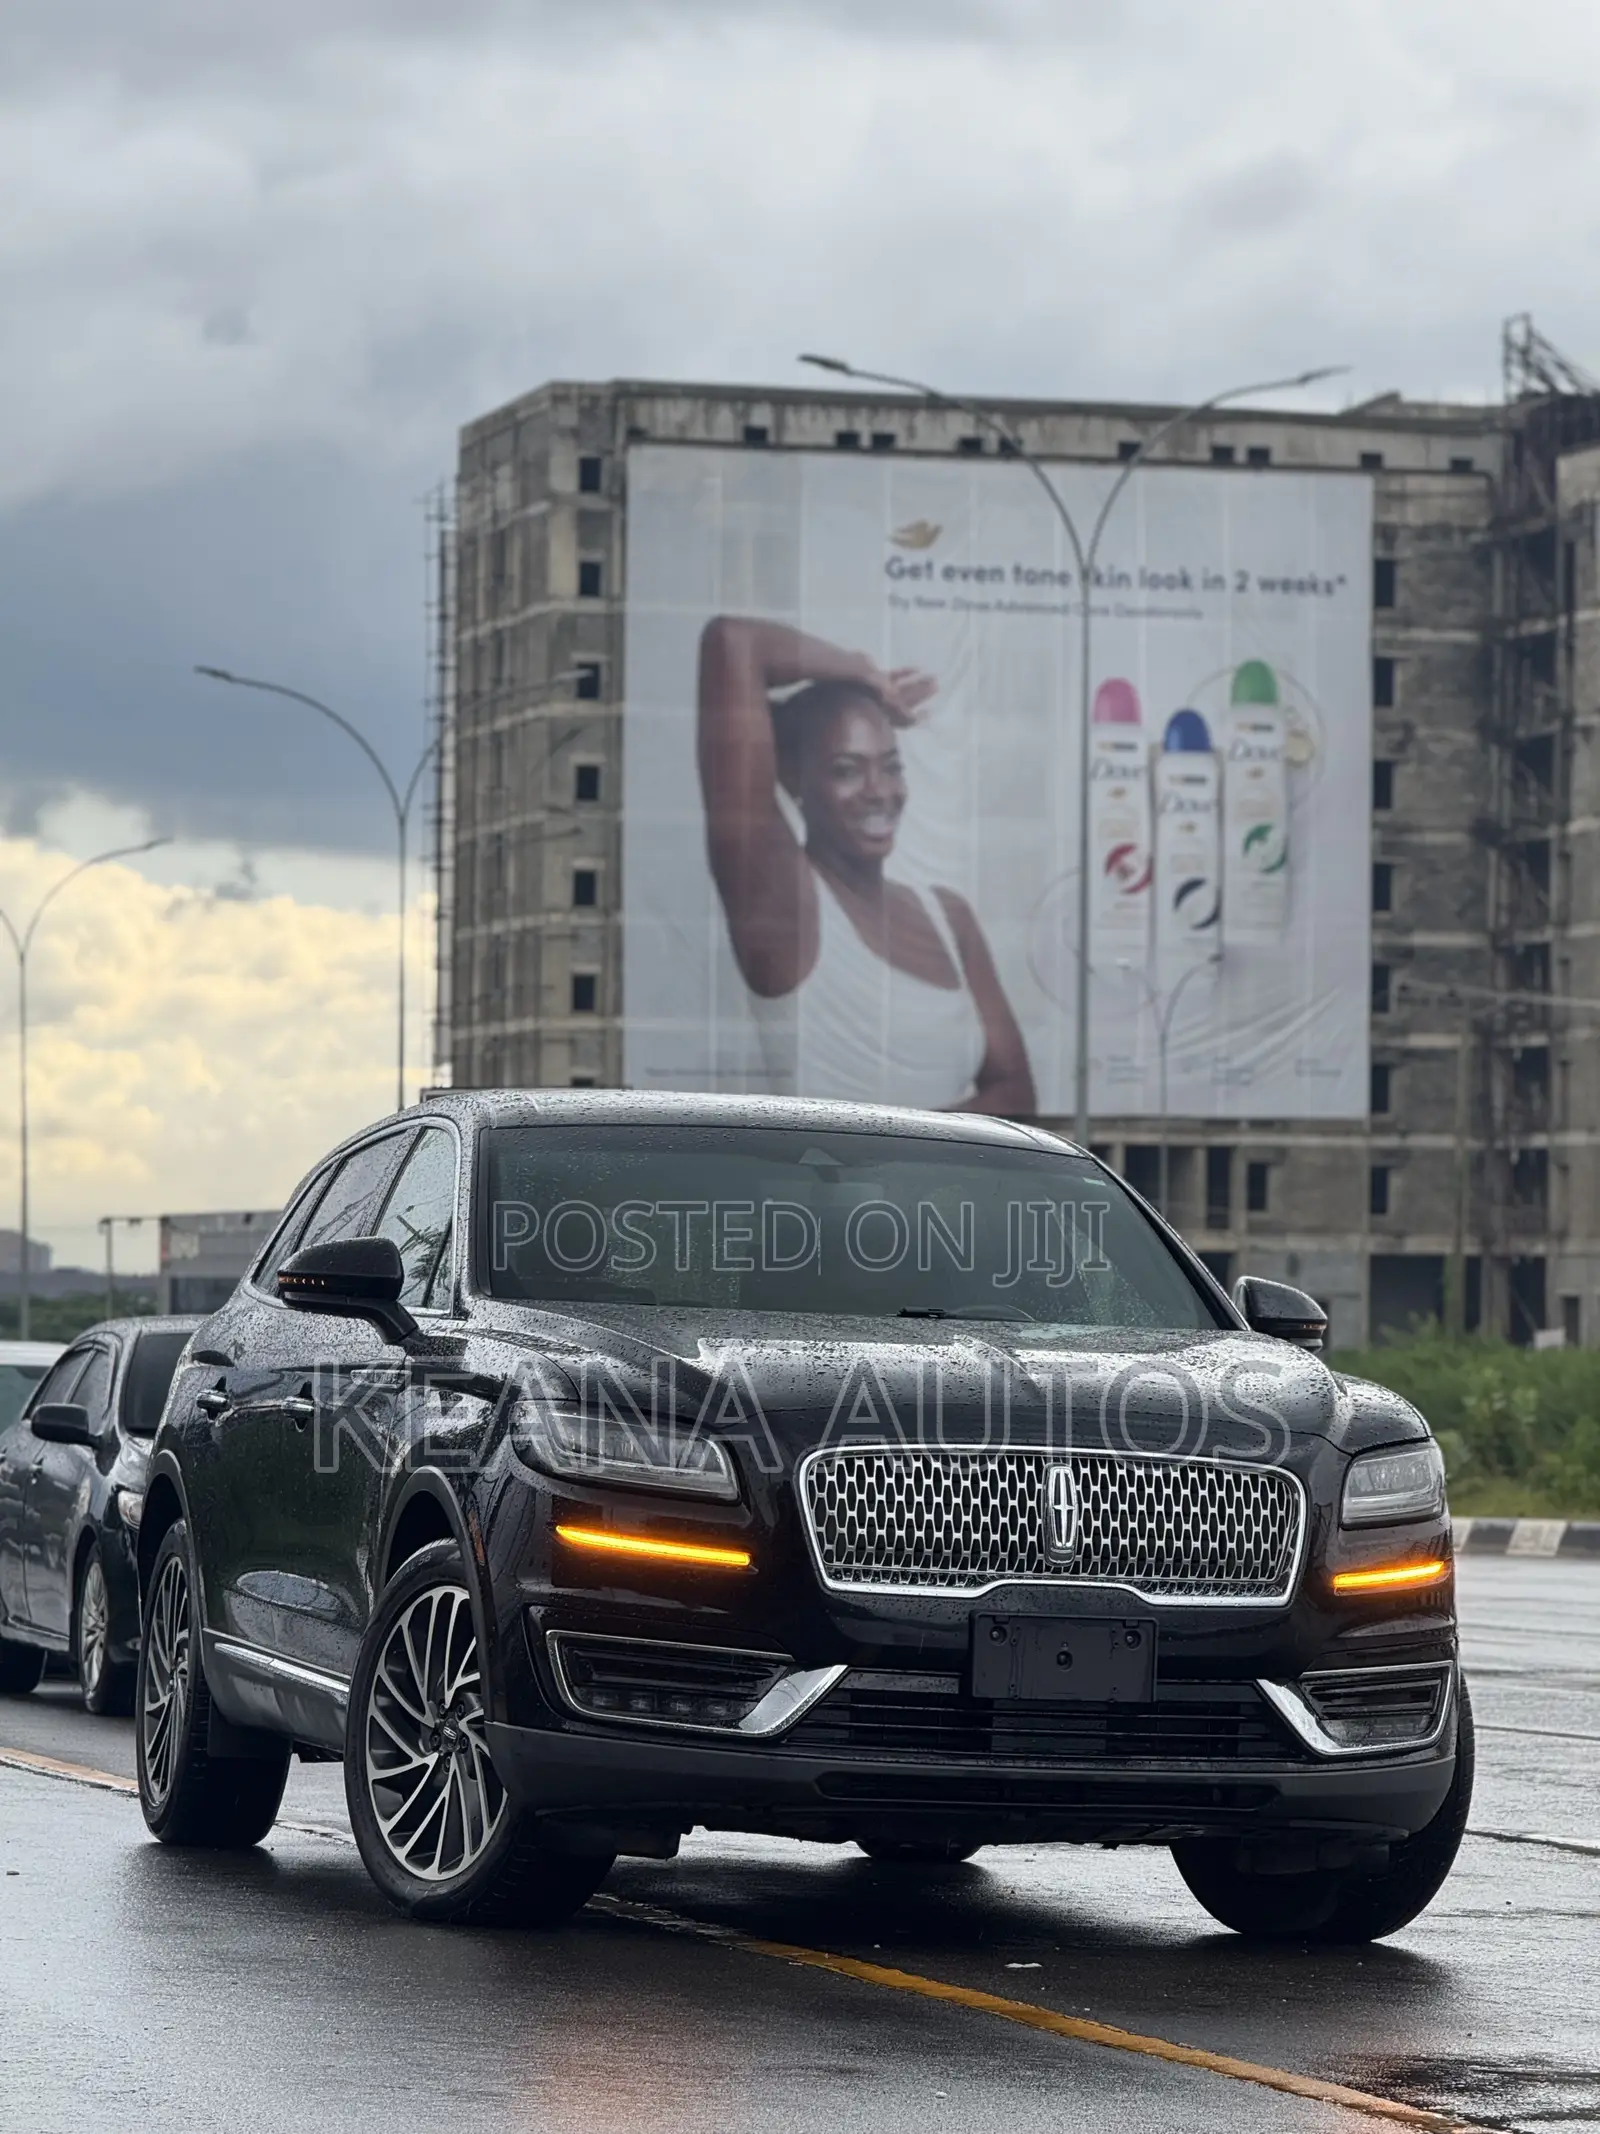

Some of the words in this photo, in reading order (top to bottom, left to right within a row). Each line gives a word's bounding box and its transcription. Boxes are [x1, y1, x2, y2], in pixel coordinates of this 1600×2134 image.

[885, 556, 934, 581] Get
[941, 563, 1005, 584] even
[1012, 562, 1072, 586] tone
[1081, 563, 1132, 590] kin
[1139, 564, 1194, 591] look
[1202, 566, 1226, 592] in
[1234, 568, 1250, 593] 2
